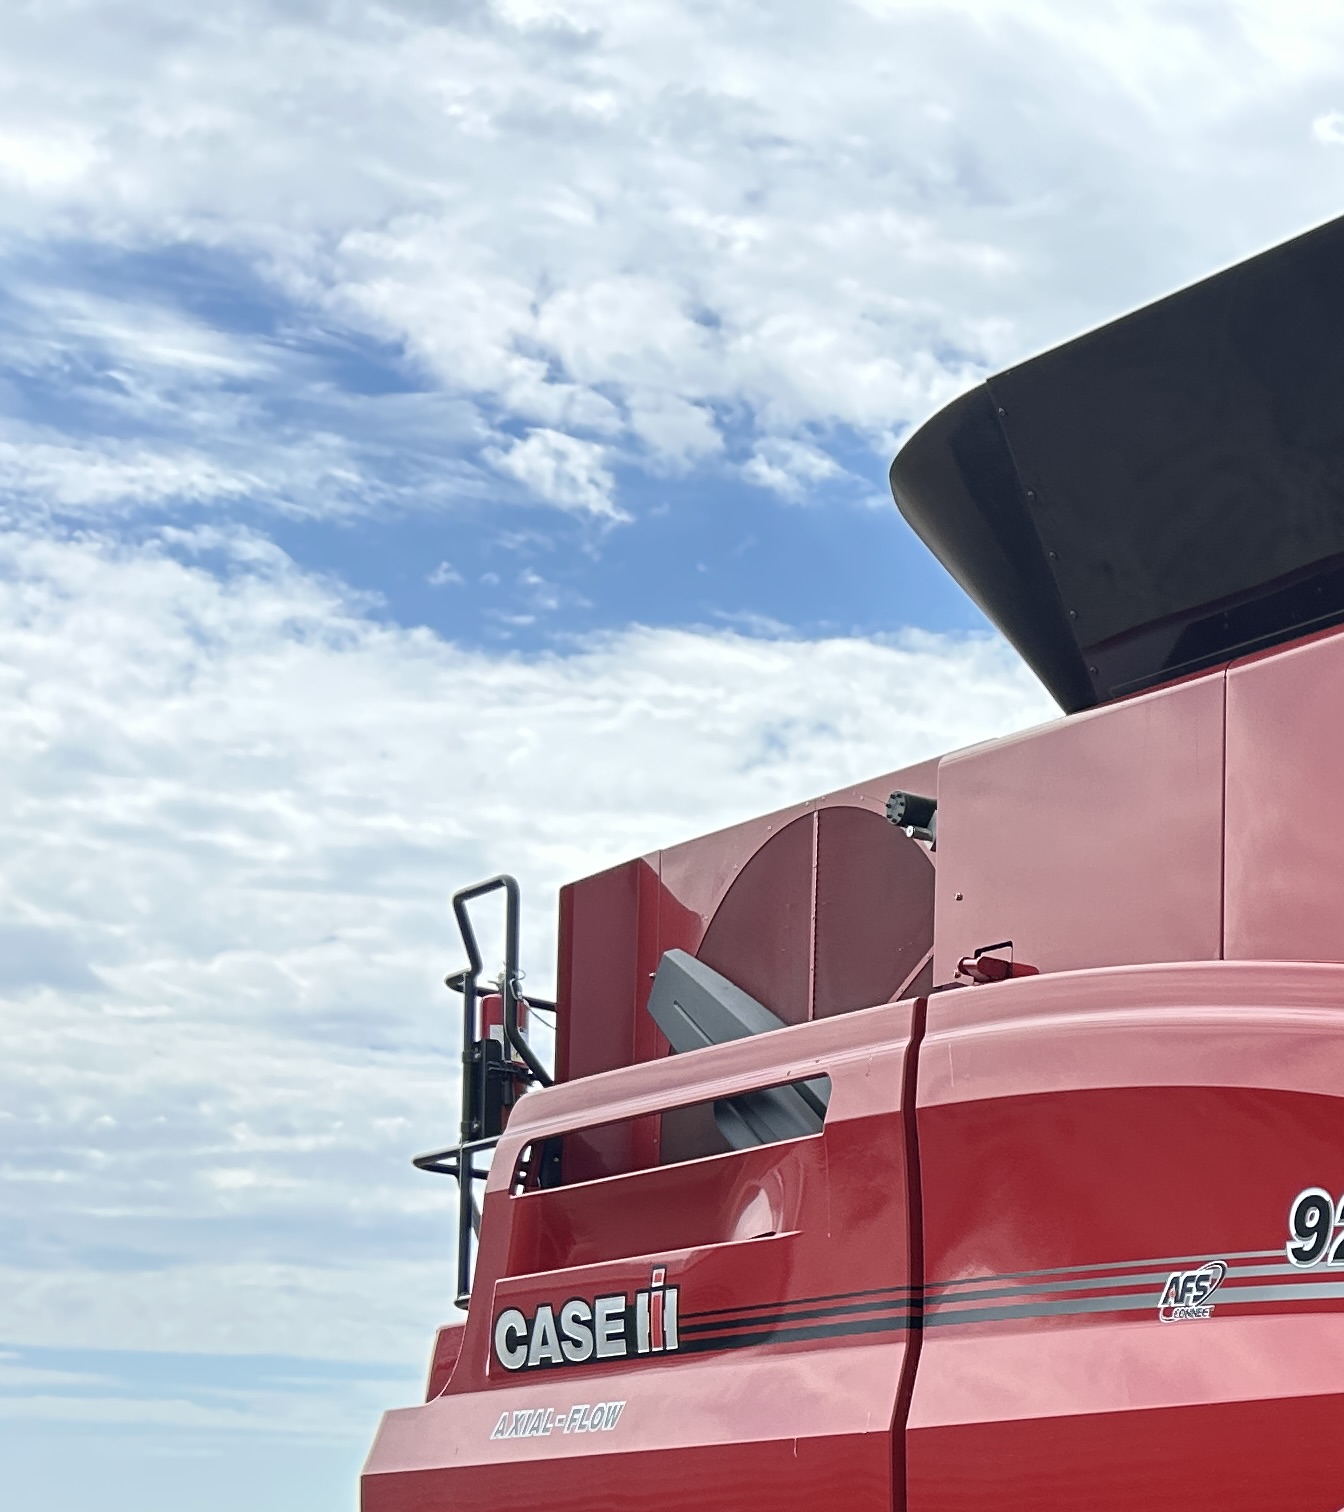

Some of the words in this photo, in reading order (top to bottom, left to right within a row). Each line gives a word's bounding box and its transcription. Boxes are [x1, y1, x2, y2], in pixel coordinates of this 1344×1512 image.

[1159, 1270, 1214, 1307] AFS
[494, 1295, 628, 1370] CASE
[490, 1400, 627, 1440] AXIAL-FLOW
